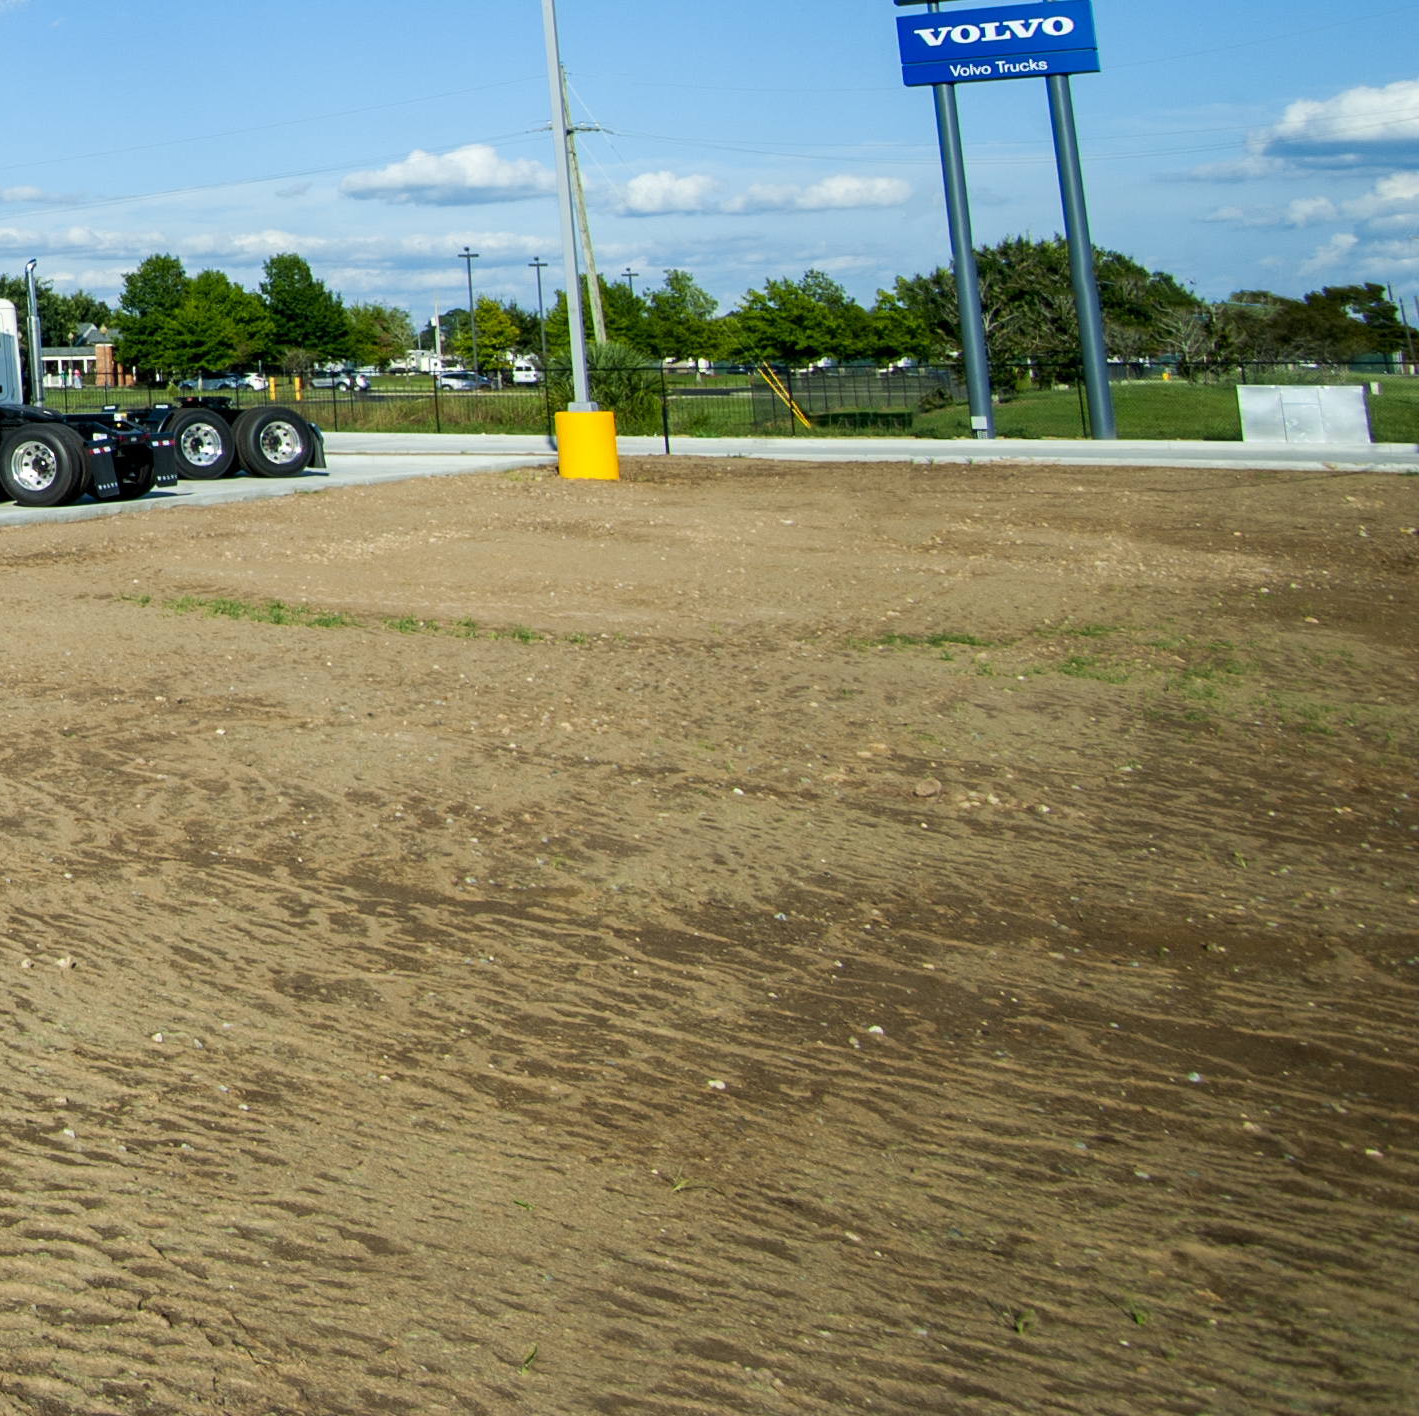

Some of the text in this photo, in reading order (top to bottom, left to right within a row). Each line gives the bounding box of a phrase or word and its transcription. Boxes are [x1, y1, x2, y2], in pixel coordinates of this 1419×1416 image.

[913, 15, 1075, 47] VOLVO
[949, 58, 1048, 78] Volvo Trucks
